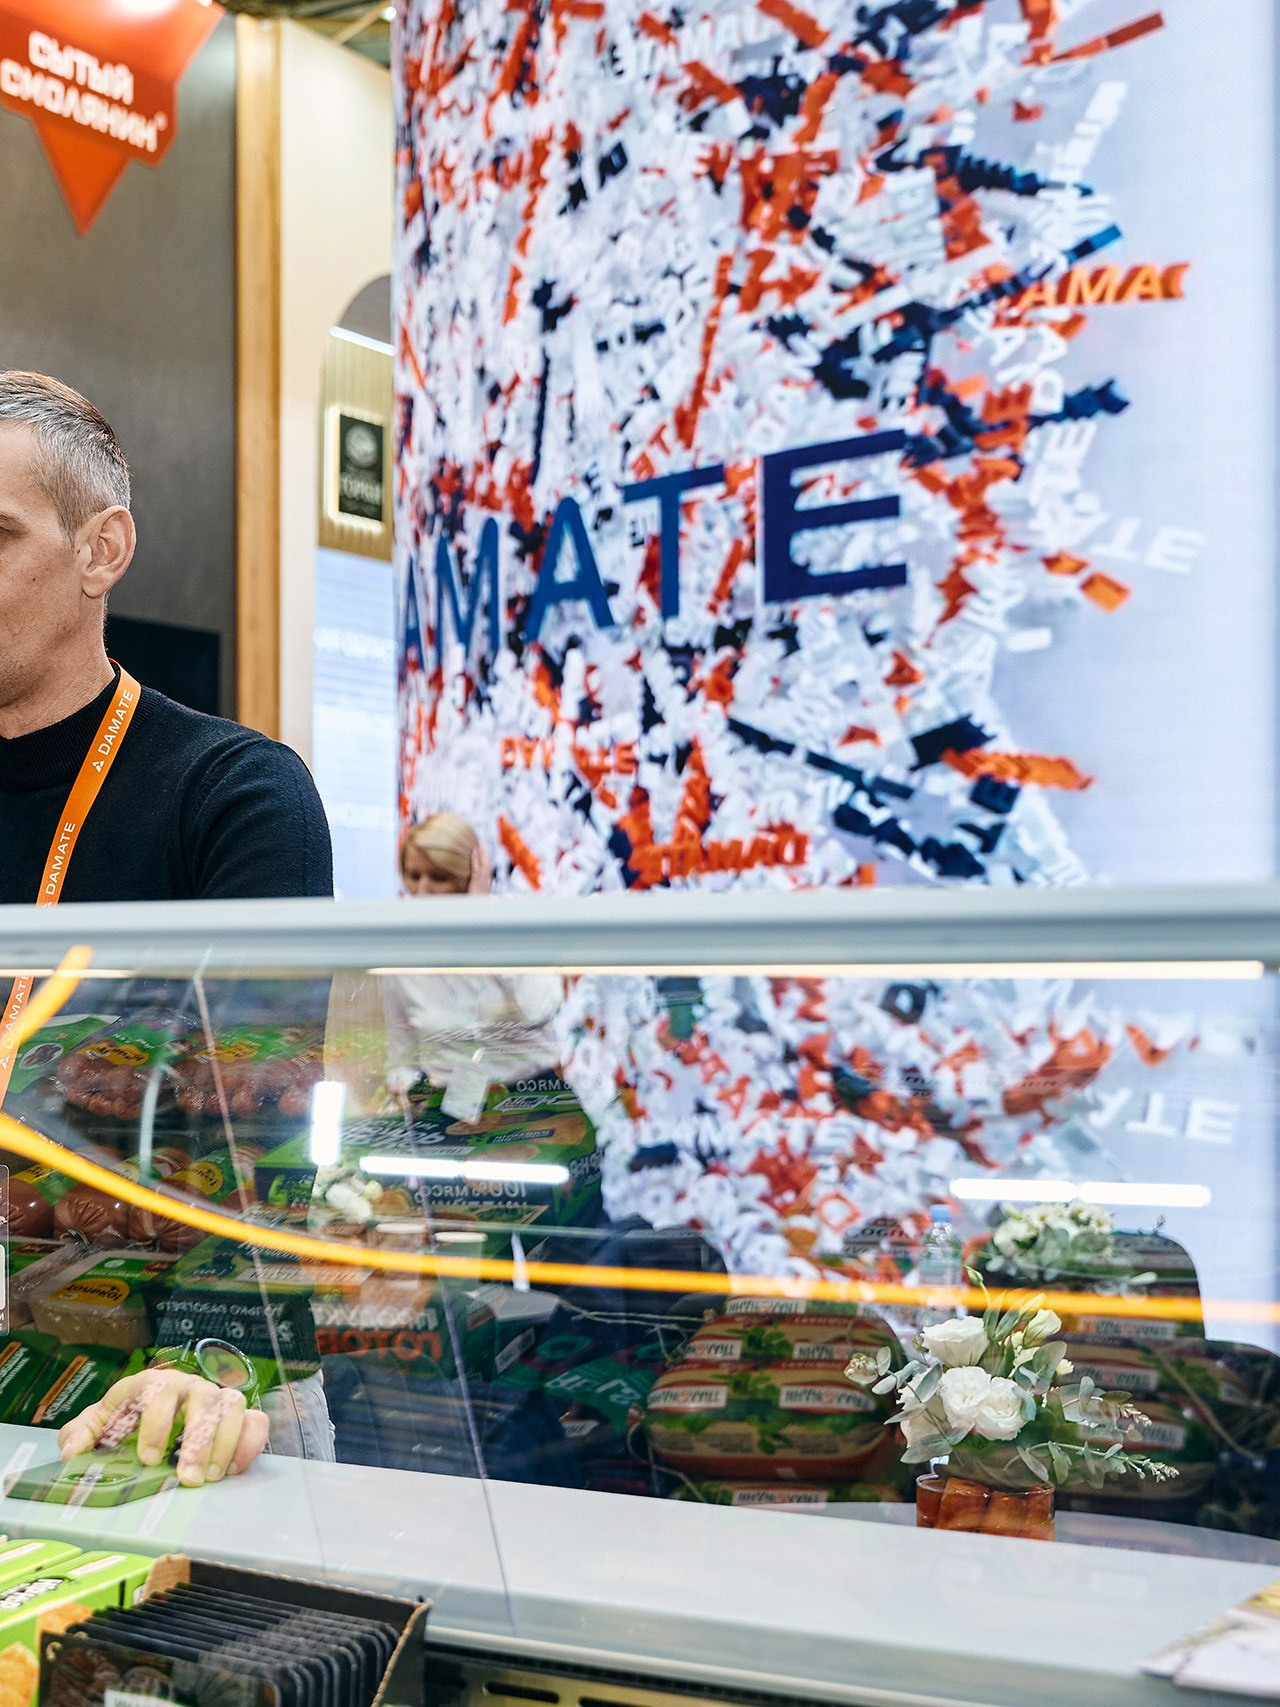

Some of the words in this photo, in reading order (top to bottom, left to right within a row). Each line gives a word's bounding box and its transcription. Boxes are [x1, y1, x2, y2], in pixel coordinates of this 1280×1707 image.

[28, 30, 135, 106] СЫТЫЙ
[97, 689, 135, 756] DAMATE
[45, 821, 77, 896] DAMATE
